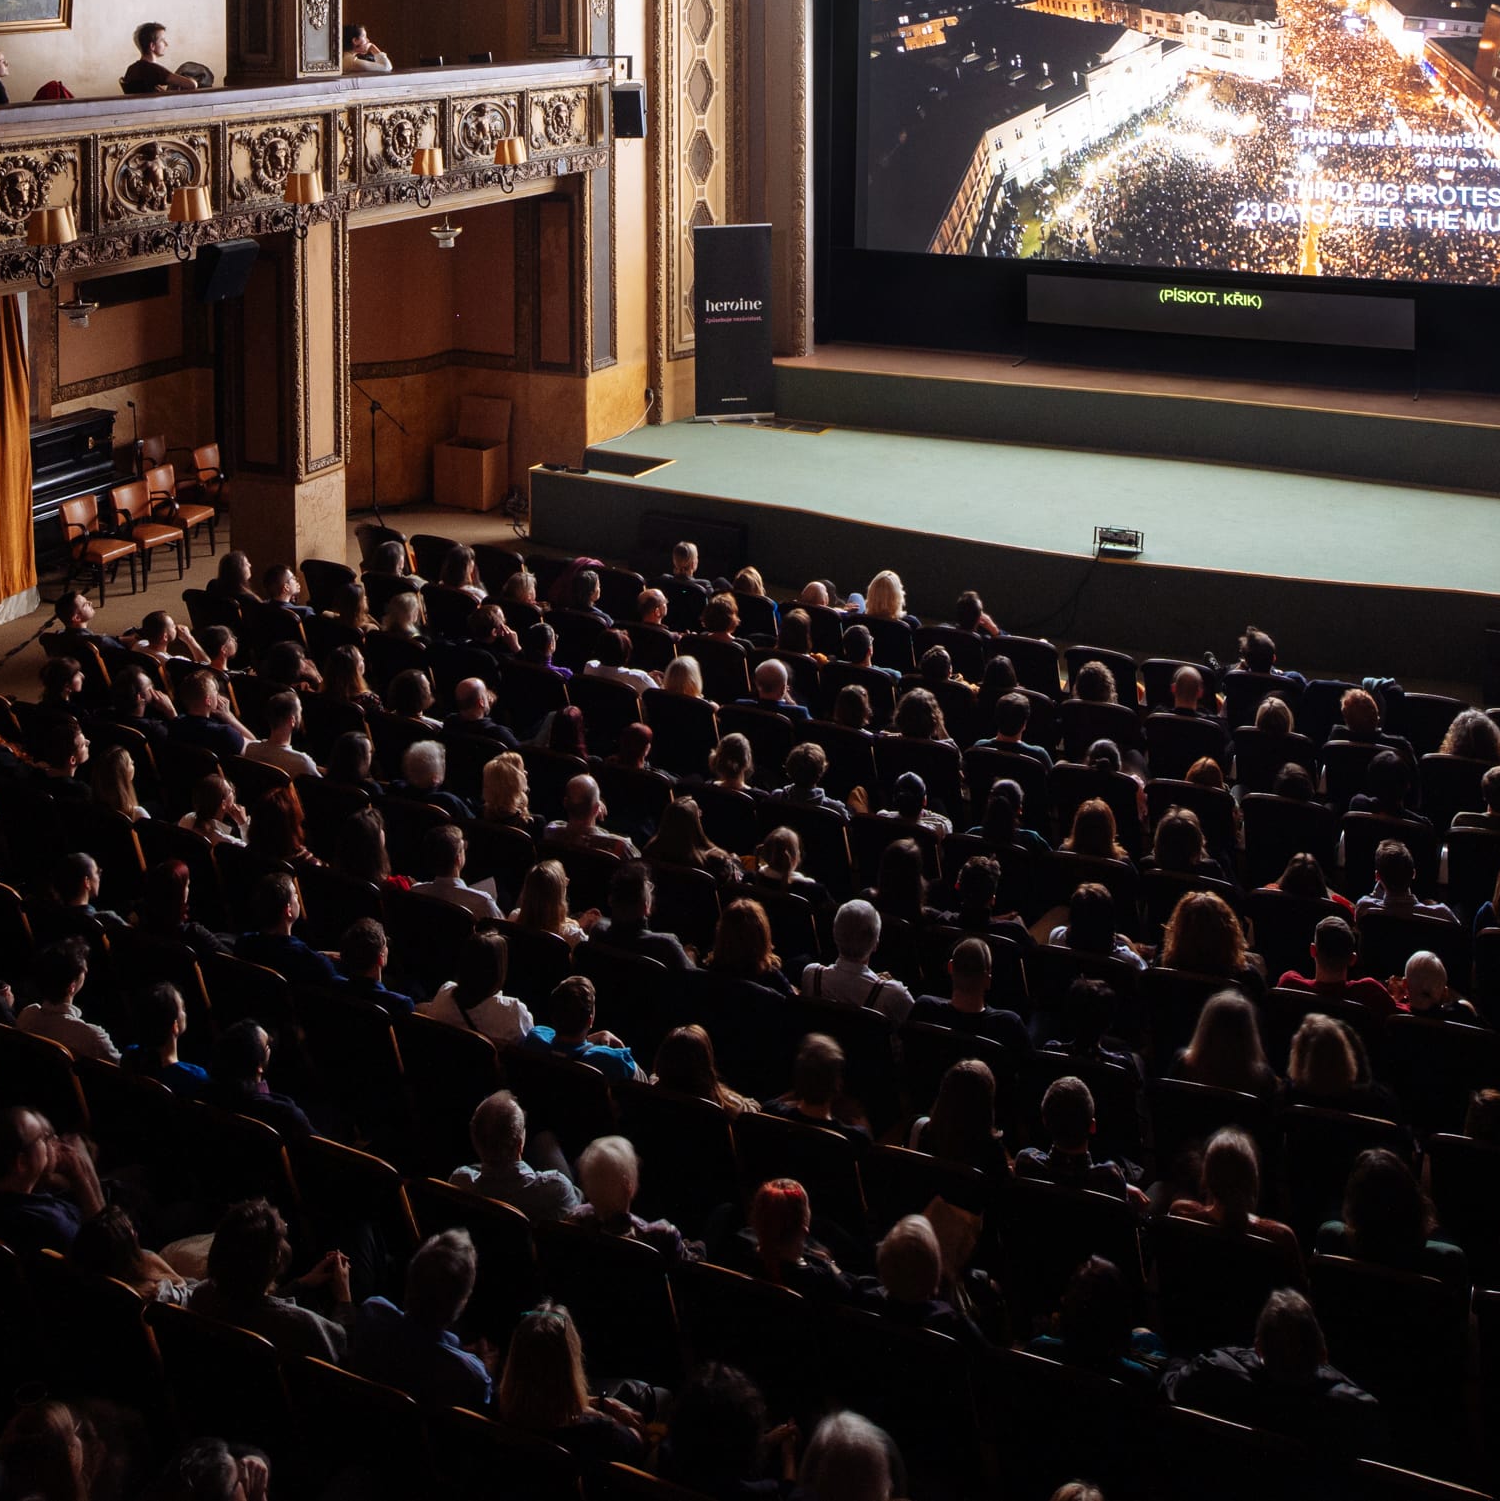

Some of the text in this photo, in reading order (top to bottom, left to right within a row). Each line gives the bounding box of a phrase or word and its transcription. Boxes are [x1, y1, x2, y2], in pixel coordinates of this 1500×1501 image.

[1415, 153, 1432, 167] 23
[1460, 157, 1479, 170] po
[1285, 178, 1354, 201] THIRD
[1359, 182, 1400, 202] BIG
[1235, 201, 1261, 222] 23
[1267, 202, 1325, 224] DAYS
[1329, 205, 1408, 228] AFTER
[1411, 209, 1462, 230] THE
[705, 297, 763, 312] heroine
[1159, 287, 1262, 310] (PÍSKOT, KŘIK)
